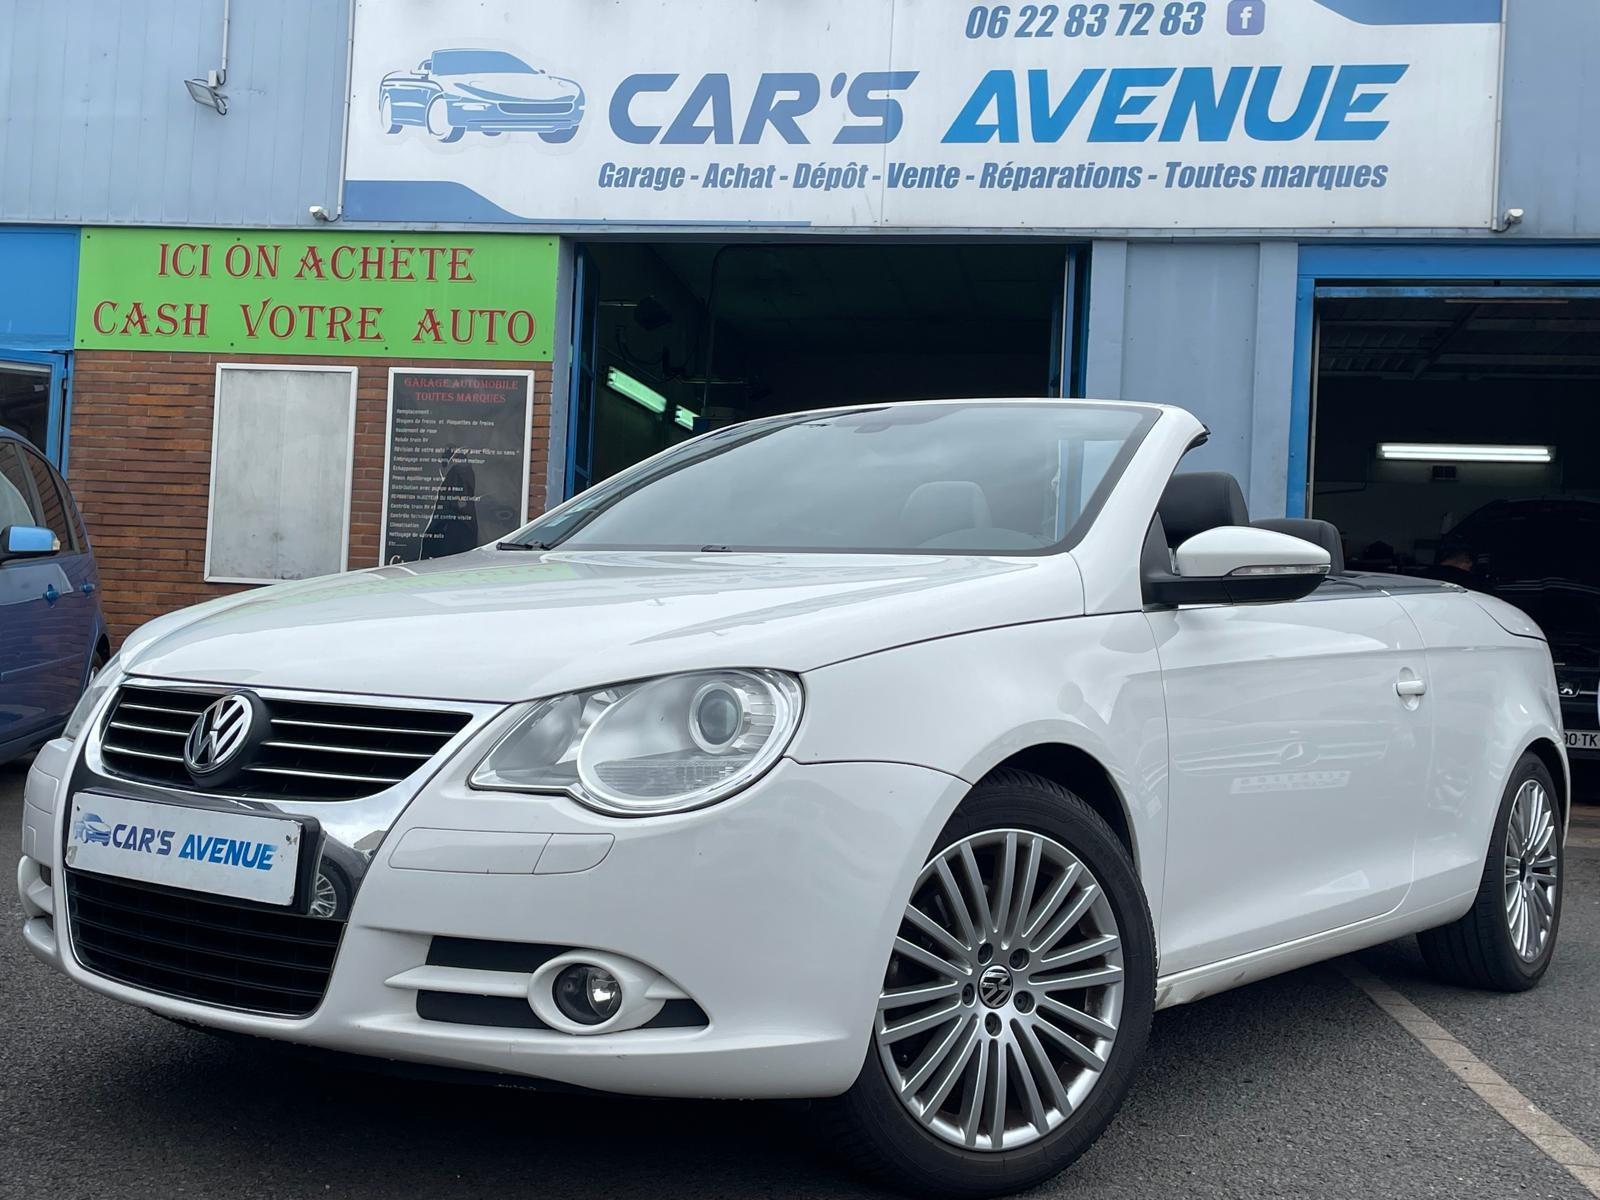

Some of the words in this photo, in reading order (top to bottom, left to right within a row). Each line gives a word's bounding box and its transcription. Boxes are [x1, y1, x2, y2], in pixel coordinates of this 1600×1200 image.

[965, 6, 1010, 39] 06
[1014, 5, 1059, 38] 22
[1064, 4, 1109, 37] 83
[1114, 3, 1155, 37] 72
[1160, 2, 1206, 36] 83
[608, 71, 920, 145] CAR'S
[940, 64, 1410, 144] AVENUE
[598, 162, 686, 192] Garage
[702, 162, 776, 189] Achat
[793, 161, 868, 191] Dépôt
[887, 162, 960, 189] Vente
[979, 160, 1143, 192] Réparations
[1164, 161, 1257, 189] Toutes
[1261, 164, 1389, 191] marques
[158, 243, 212, 277] ICI
[224, 244, 281, 279] ON
[294, 246, 475, 282] ACHETE
[93, 300, 209, 337] CASH
[239, 297, 385, 342] VOTRE
[411, 308, 537, 345] AUTO
[403, 377, 449, 389] GARAGE
[452, 378, 518, 390] AUTOMOBILE
[415, 391, 454, 401] TOUTES
[456, 393, 506, 403] MARQUES
[112, 823, 176, 856] CAR'S
[178, 833, 279, 871] AVENUE
